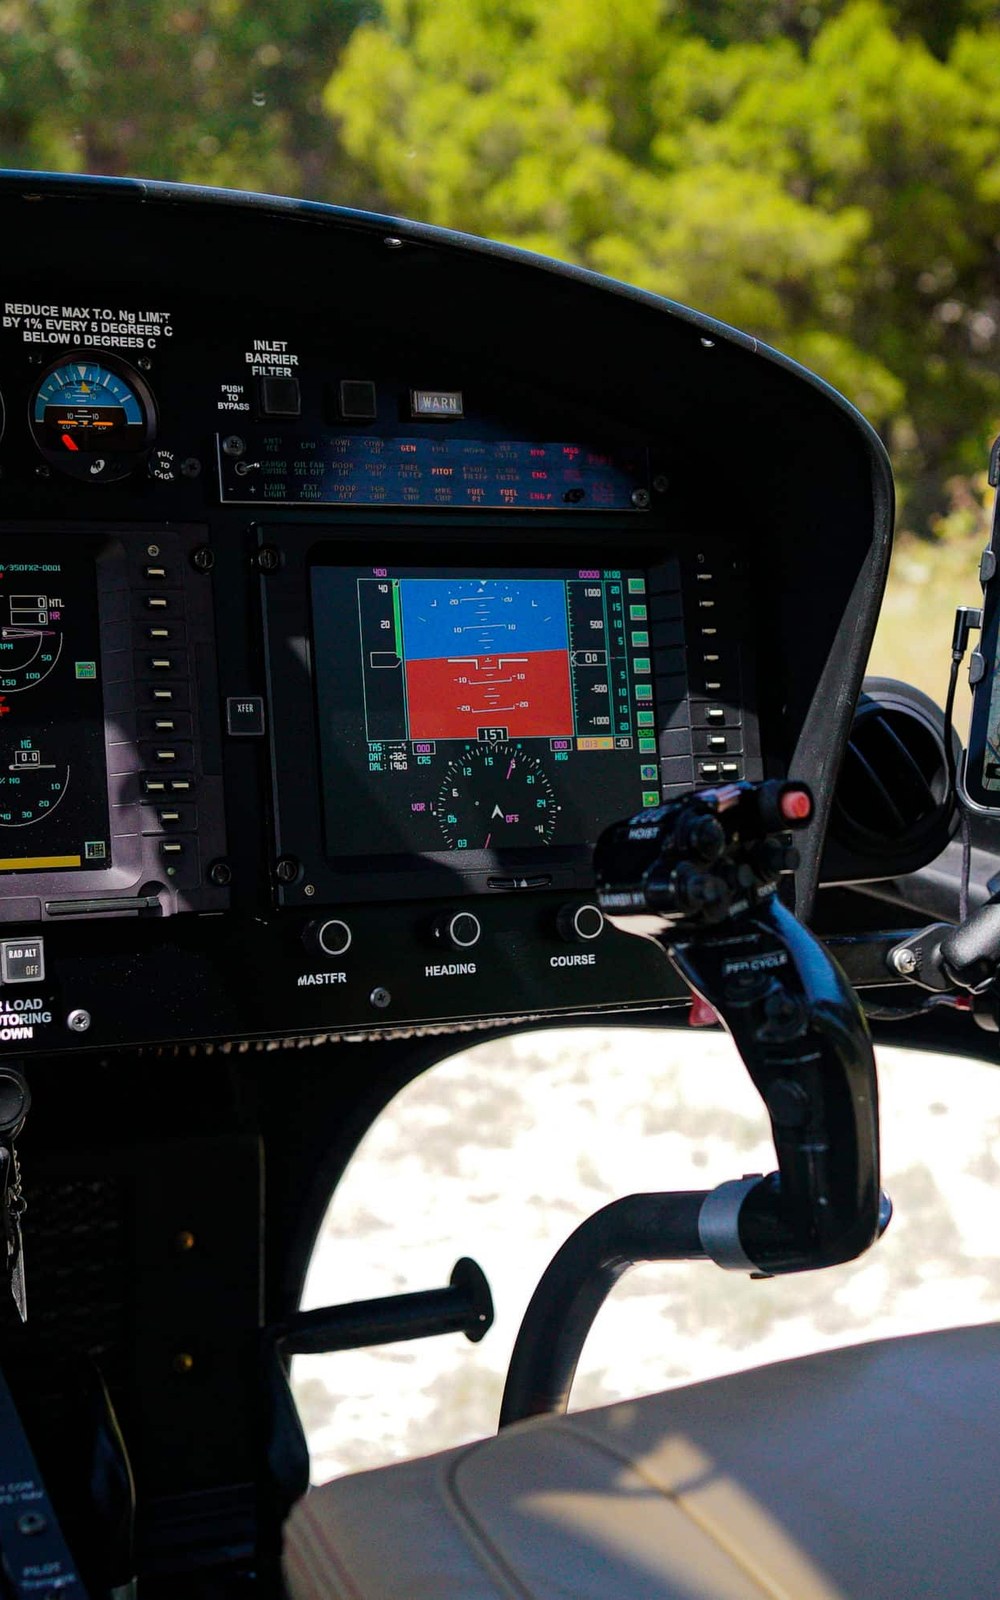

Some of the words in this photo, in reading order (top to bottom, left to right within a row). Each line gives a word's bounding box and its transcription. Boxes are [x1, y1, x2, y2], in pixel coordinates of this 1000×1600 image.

[5, 303, 59, 317] REDUCE
[62, 308, 90, 319] MAX
[93, 308, 116, 321] T.O.
[119, 311, 135, 324] Ng
[138, 312, 171, 324] LIMIT
[3, 316, 21, 328] BY
[24, 318, 42, 330] 1%
[46, 319, 88, 333] EVERY
[90, 322, 98, 333] 5
[101, 322, 160, 336] DEGREES
[164, 326, 173, 337] C
[23, 331, 70, 345] BELOW
[73, 334, 80, 345] 0
[84, 335, 144, 348] DEGREES
[147, 338, 156, 349] C
[253, 340, 288, 352] INLET
[245, 353, 298, 365] BARRIER
[252, 366, 292, 377] FILTER
[221, 384, 243, 393] PUSH
[227, 394, 239, 402] TO
[422, 396, 456, 409] WARN
[217, 402, 250, 411] BYPASS
[400, 444, 416, 453] GEN
[157, 450, 174, 461] PULL
[160, 461, 170, 469] TO
[154, 469, 174, 480] CAGE
[431, 467, 453, 476] PITOT
[467, 488, 485, 496] FUEL
[500, 489, 518, 497] FUEL
[373, 568, 388, 577] 400
[378, 584, 389, 593] 40
[584, 588, 601, 597] 1000
[610, 586, 620, 594] 20
[38, 597, 46, 608] 0
[612, 603, 621, 611] 15
[38, 612, 46, 623] 0
[380, 620, 391, 629] 20
[589, 620, 603, 629] 500
[613, 620, 622, 628] 10
[618, 636, 624, 645] 5
[41, 654, 52, 662] 50
[25, 672, 41, 680] 100
[620, 671, 626, 679] 5
[454, 676, 467, 684] -10
[590, 684, 608, 693] -500
[618, 688, 627, 696] 10
[236, 703, 254, 713] XFER
[620, 705, 628, 714] 15
[589, 716, 610, 725] -1000
[619, 722, 629, 731] 20
[484, 729, 504, 740] 157
[21, 752, 38, 762] 0.0
[417, 756, 432, 765] CRS
[484, 757, 494, 766] 15
[463, 767, 472, 776] 12
[526, 775, 535, 784] 21
[411, 802, 426, 812] VOR
[536, 799, 547, 808] 24
[447, 814, 458, 824] 06
[457, 838, 468, 848] 03
[8, 949, 23, 959] RAD
[24, 948, 37, 958] ALT
[549, 954, 596, 968] COURSE
[25, 965, 39, 975] OFF
[425, 963, 477, 977] HEADING
[297, 972, 347, 986] MASTER
[5, 998, 43, 1012] LOAD
[0, 1026, 33, 1041] OWN
